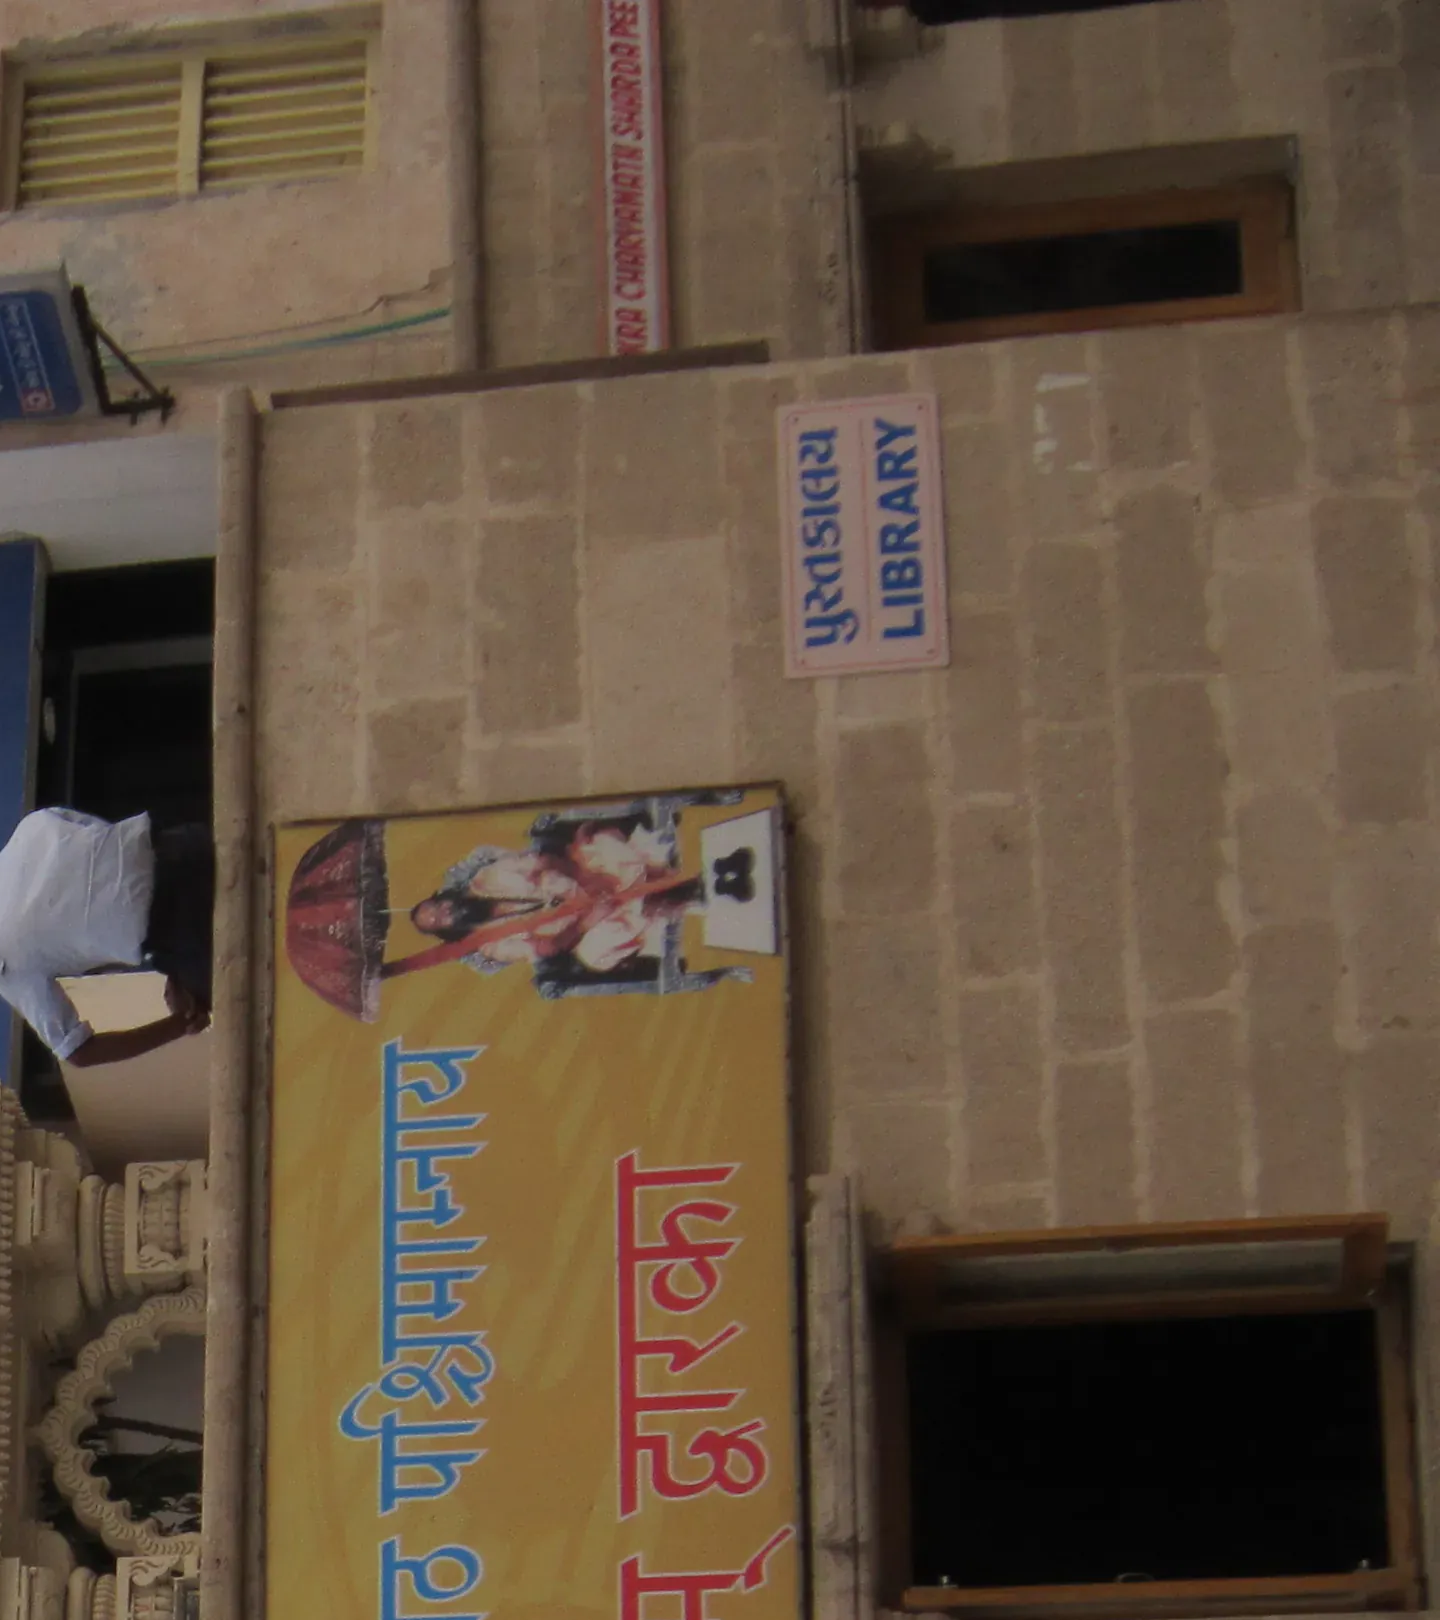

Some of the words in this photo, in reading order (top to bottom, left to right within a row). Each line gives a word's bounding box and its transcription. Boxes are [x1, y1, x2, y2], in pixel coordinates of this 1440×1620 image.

[798, 426, 859, 648] પુસ્તકાલય
[874, 417, 926, 639] LIBRARY
[338, 1040, 493, 1516] पश्चिमाम्नाय
[615, 1148, 768, 1518] द्वारका
